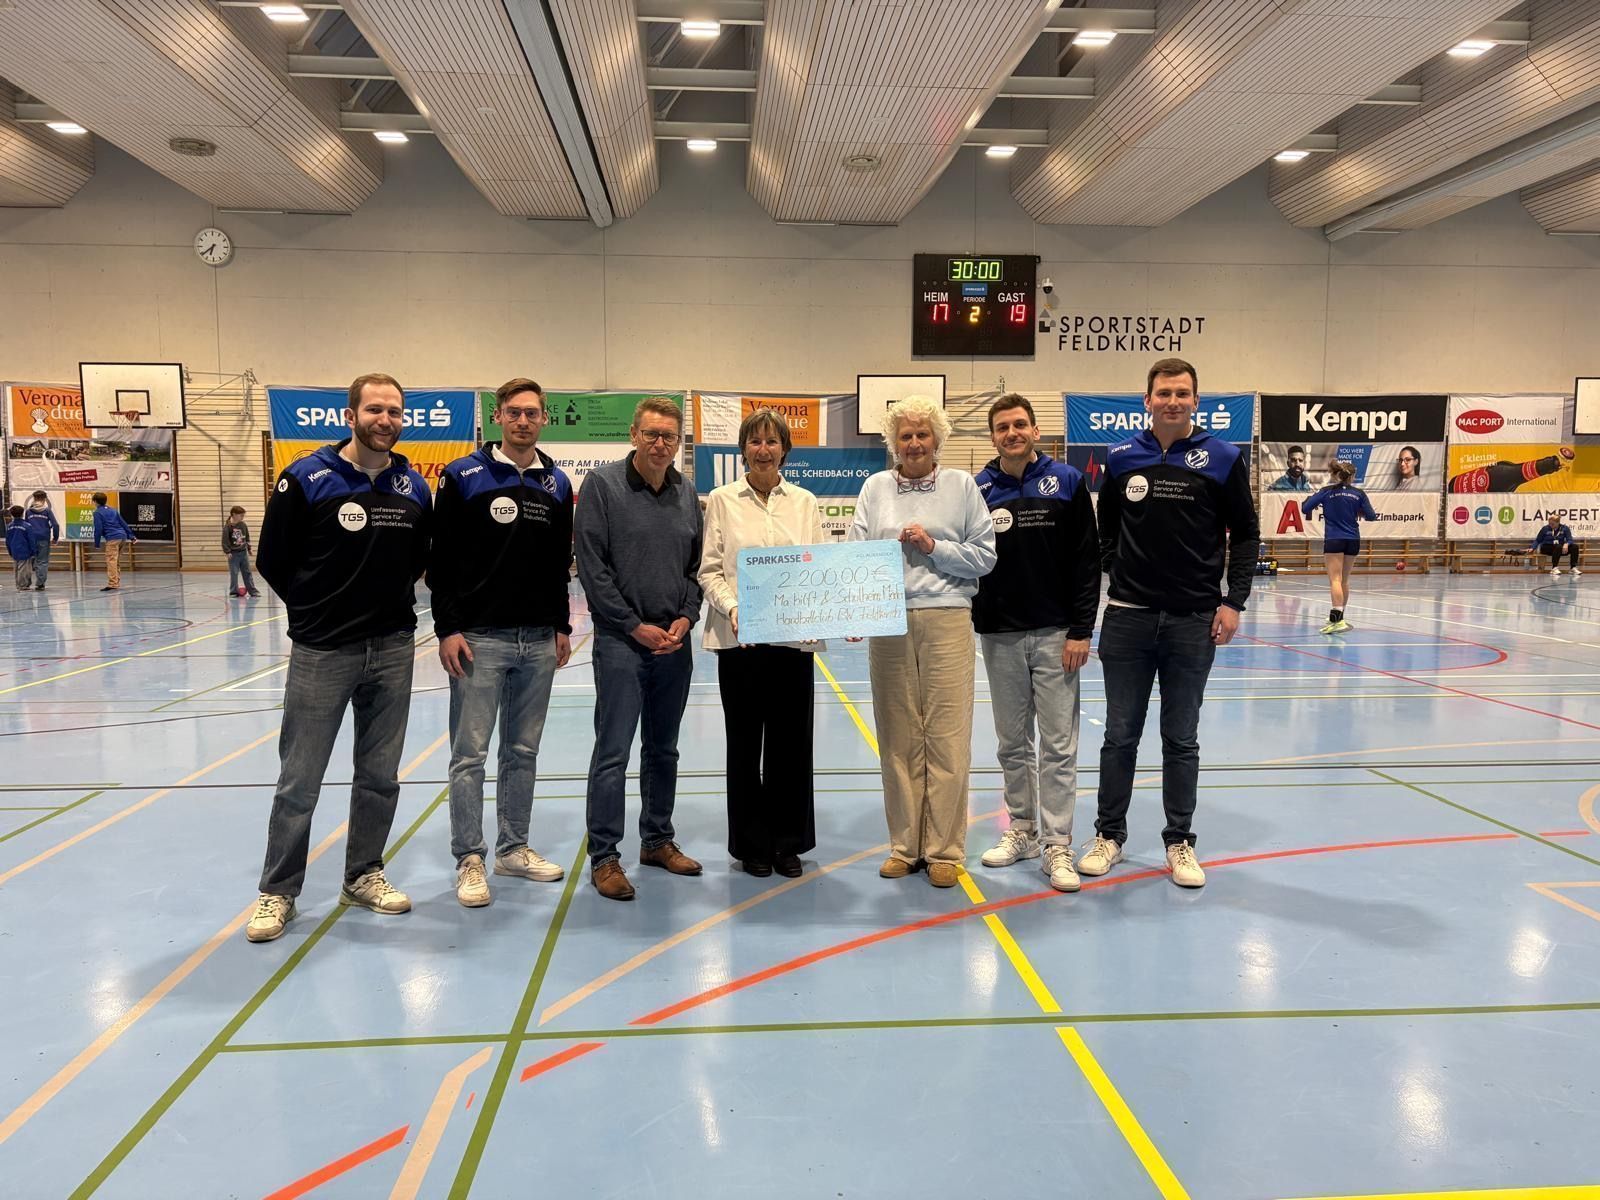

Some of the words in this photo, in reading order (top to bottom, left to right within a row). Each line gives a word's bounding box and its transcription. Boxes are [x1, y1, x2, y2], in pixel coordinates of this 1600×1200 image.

[952, 261, 1000, 279] 30:00
[924, 292, 949, 302] HEIM
[997, 292, 1026, 302] GAST
[933, 303, 949, 321] 17
[969, 305, 980, 322] 2
[1010, 304, 1026, 322] 19
[1060, 316, 1206, 334] SPORTSTADT
[1059, 335, 1182, 351] FELDKIRCH
[19, 389, 82, 407] Verona
[50, 404, 83, 420] due
[296, 407, 426, 427] SPASE
[1089, 412, 1208, 430] SPARKSE
[1298, 403, 1408, 439] Kempa
[1458, 418, 1478, 426] MAC
[1480, 418, 1502, 426] PORT
[1506, 418, 1557, 426] International
[1111, 443, 1132, 455] Kempa
[307, 468, 333, 483] Kempa
[460, 465, 484, 478] Kempa
[784, 470, 800, 478] FIEL
[802, 470, 854, 478] SCHEIDBACH
[1127, 485, 1147, 494] TGS
[340, 513, 364, 522] TGS
[492, 506, 516, 515] TGS
[1276, 500, 1304, 535] A
[1375, 513, 1425, 522] Zimbapark
[1522, 508, 1599, 521] LAMPERT
[1577, 521, 1596, 530] dran.
[746, 554, 801, 566] SPARKASSE
[871, 564, 891, 582] €
